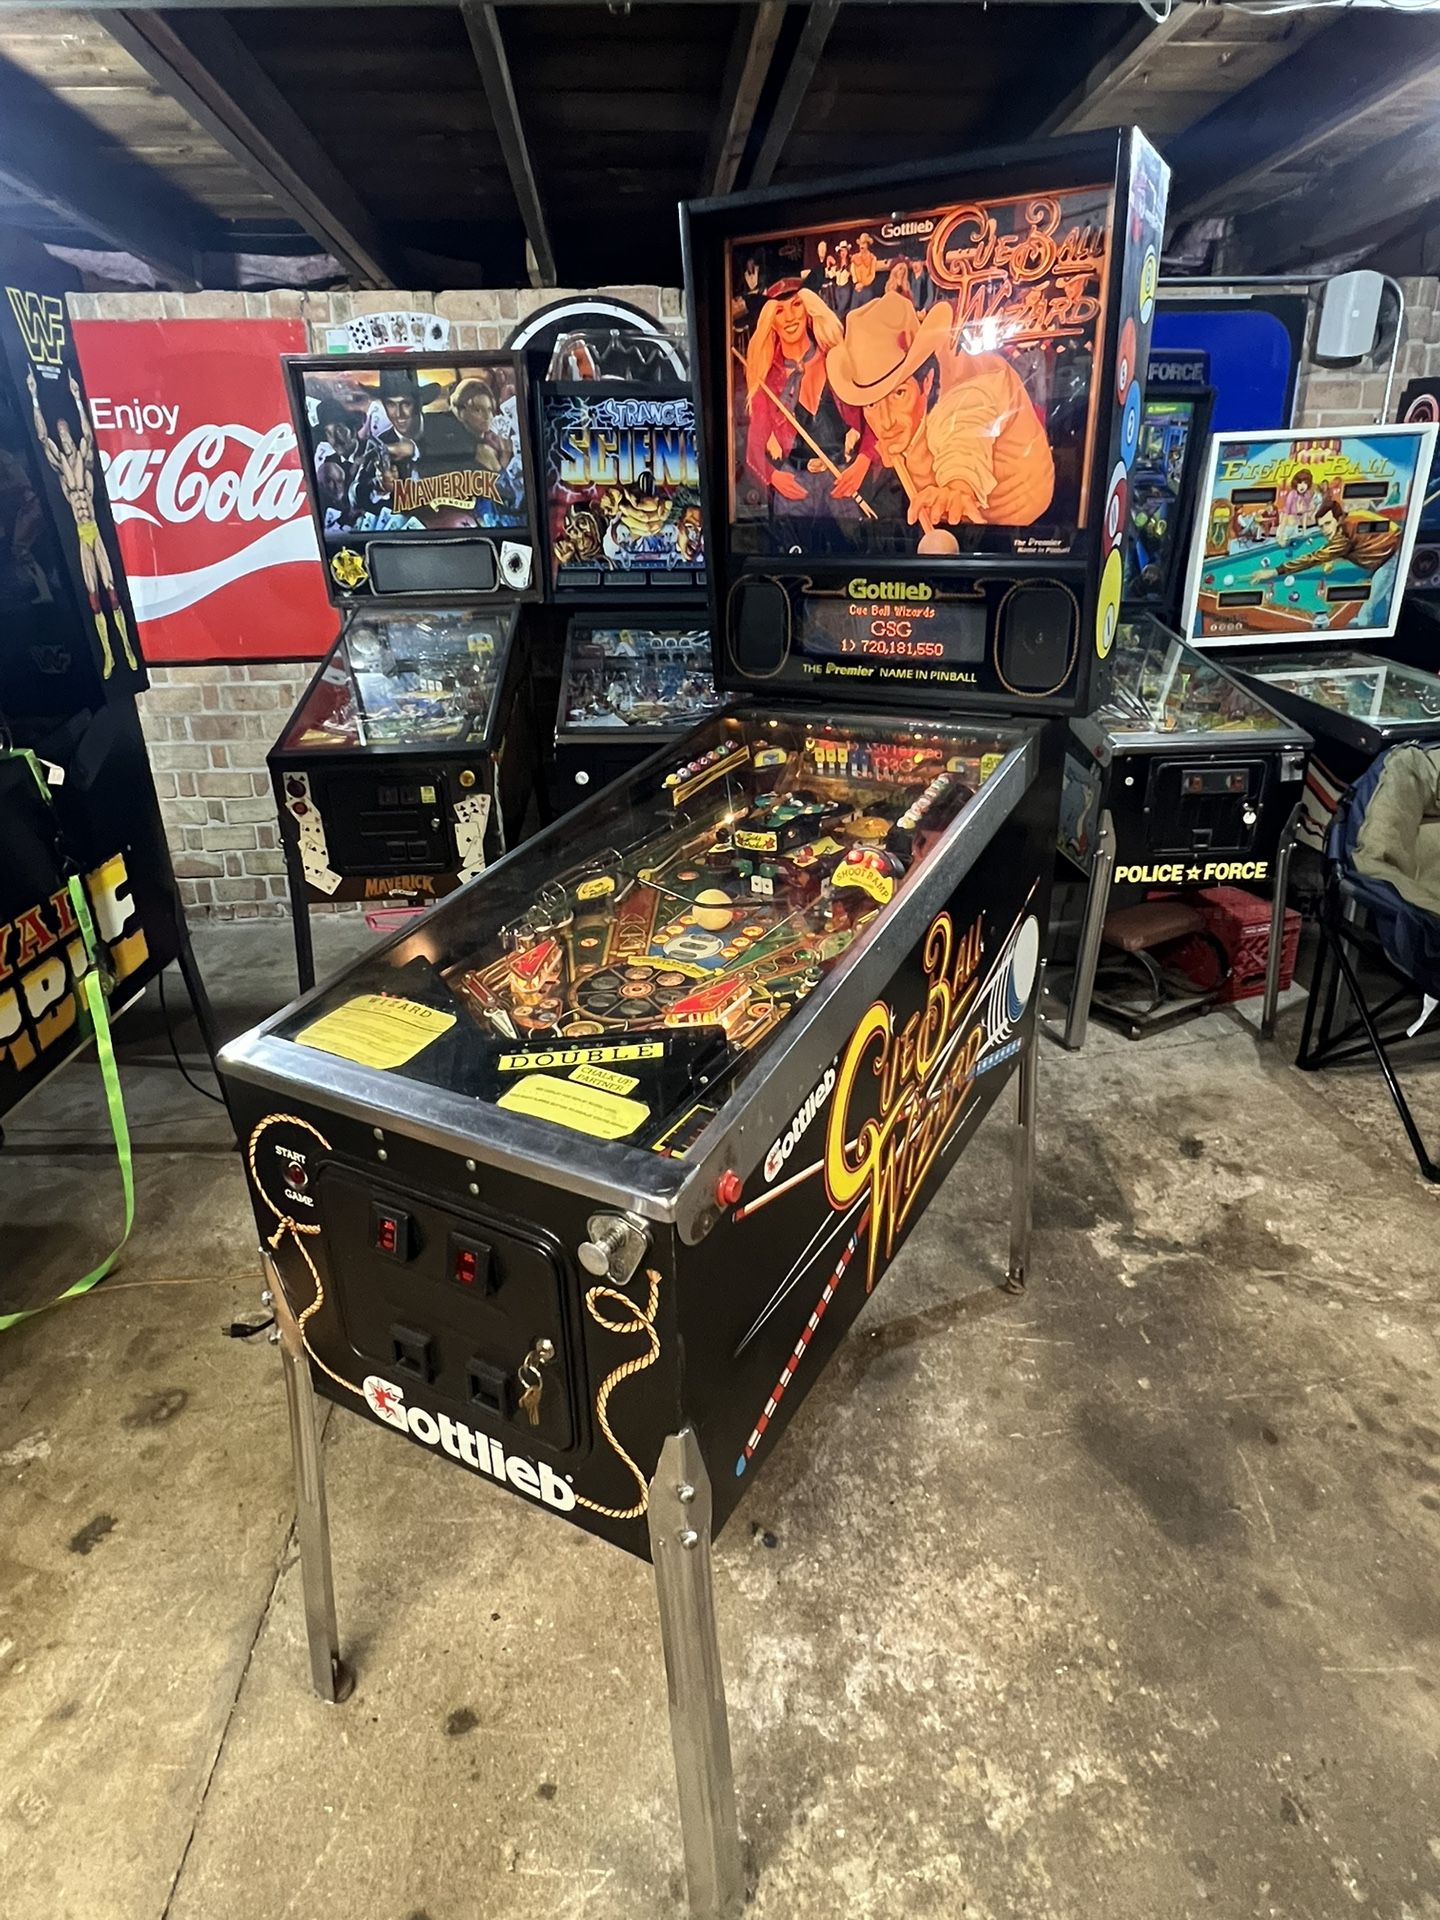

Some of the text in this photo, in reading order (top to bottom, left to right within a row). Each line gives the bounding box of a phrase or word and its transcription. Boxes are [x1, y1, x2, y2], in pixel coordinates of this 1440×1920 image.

[881, 221, 935, 239] Gottlieb
[1147, 362, 1205, 381] FORCE
[89, 398, 180, 435] Enjoy
[605, 398, 689, 427] STRANGE
[1324, 455, 1395, 478] BALL
[393, 469, 504, 514] MAVERICK
[848, 577, 933, 601] Gottlieb
[849, 603, 936, 619] Cue Ball Wizards
[870, 620, 913, 638] GSG
[861, 639, 944, 657] 720,181,550
[803, 661, 978, 684] THE Premier NAME IN PINBALL
[836, 867, 867, 882] SHOOT
[1114, 861, 1269, 884] POLICE FORCE
[364, 874, 436, 898] MAVERICK
[368, 997, 433, 1018] WIZARD
[509, 1045, 655, 1068] DOUBLE
[575, 1073, 624, 1093] PARTNER
[580, 1066, 616, 1083] CHALK
[763, 1068, 836, 1183] Gottlieb
[274, 1145, 306, 1165] START
[284, 1188, 315, 1208] GAME
[362, 1375, 576, 1512] Gottlieb
